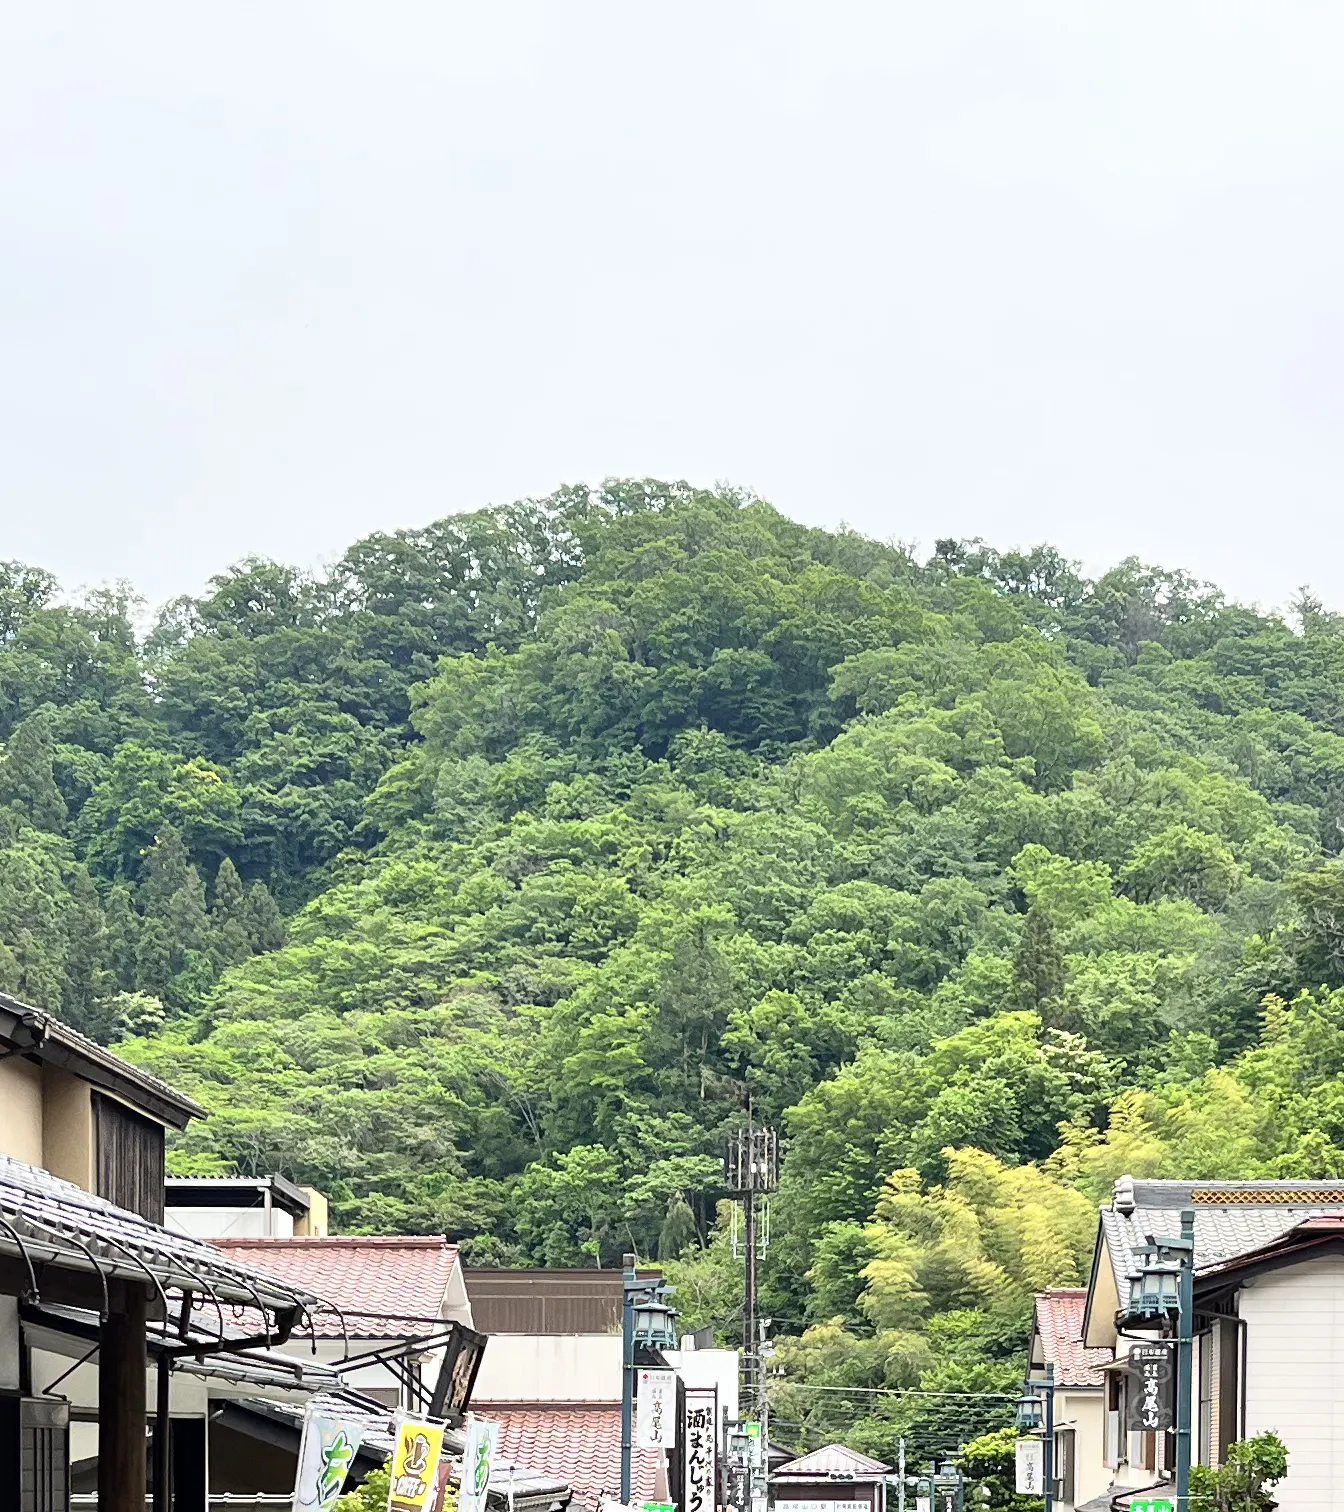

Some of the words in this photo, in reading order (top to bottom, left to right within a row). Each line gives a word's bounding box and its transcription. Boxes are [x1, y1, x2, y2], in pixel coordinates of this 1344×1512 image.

[649, 1400, 663, 1444] 高尾山
[1141, 1377, 1160, 1428] 高尾山
[686, 1408, 706, 1512] 酒まんじゅう
